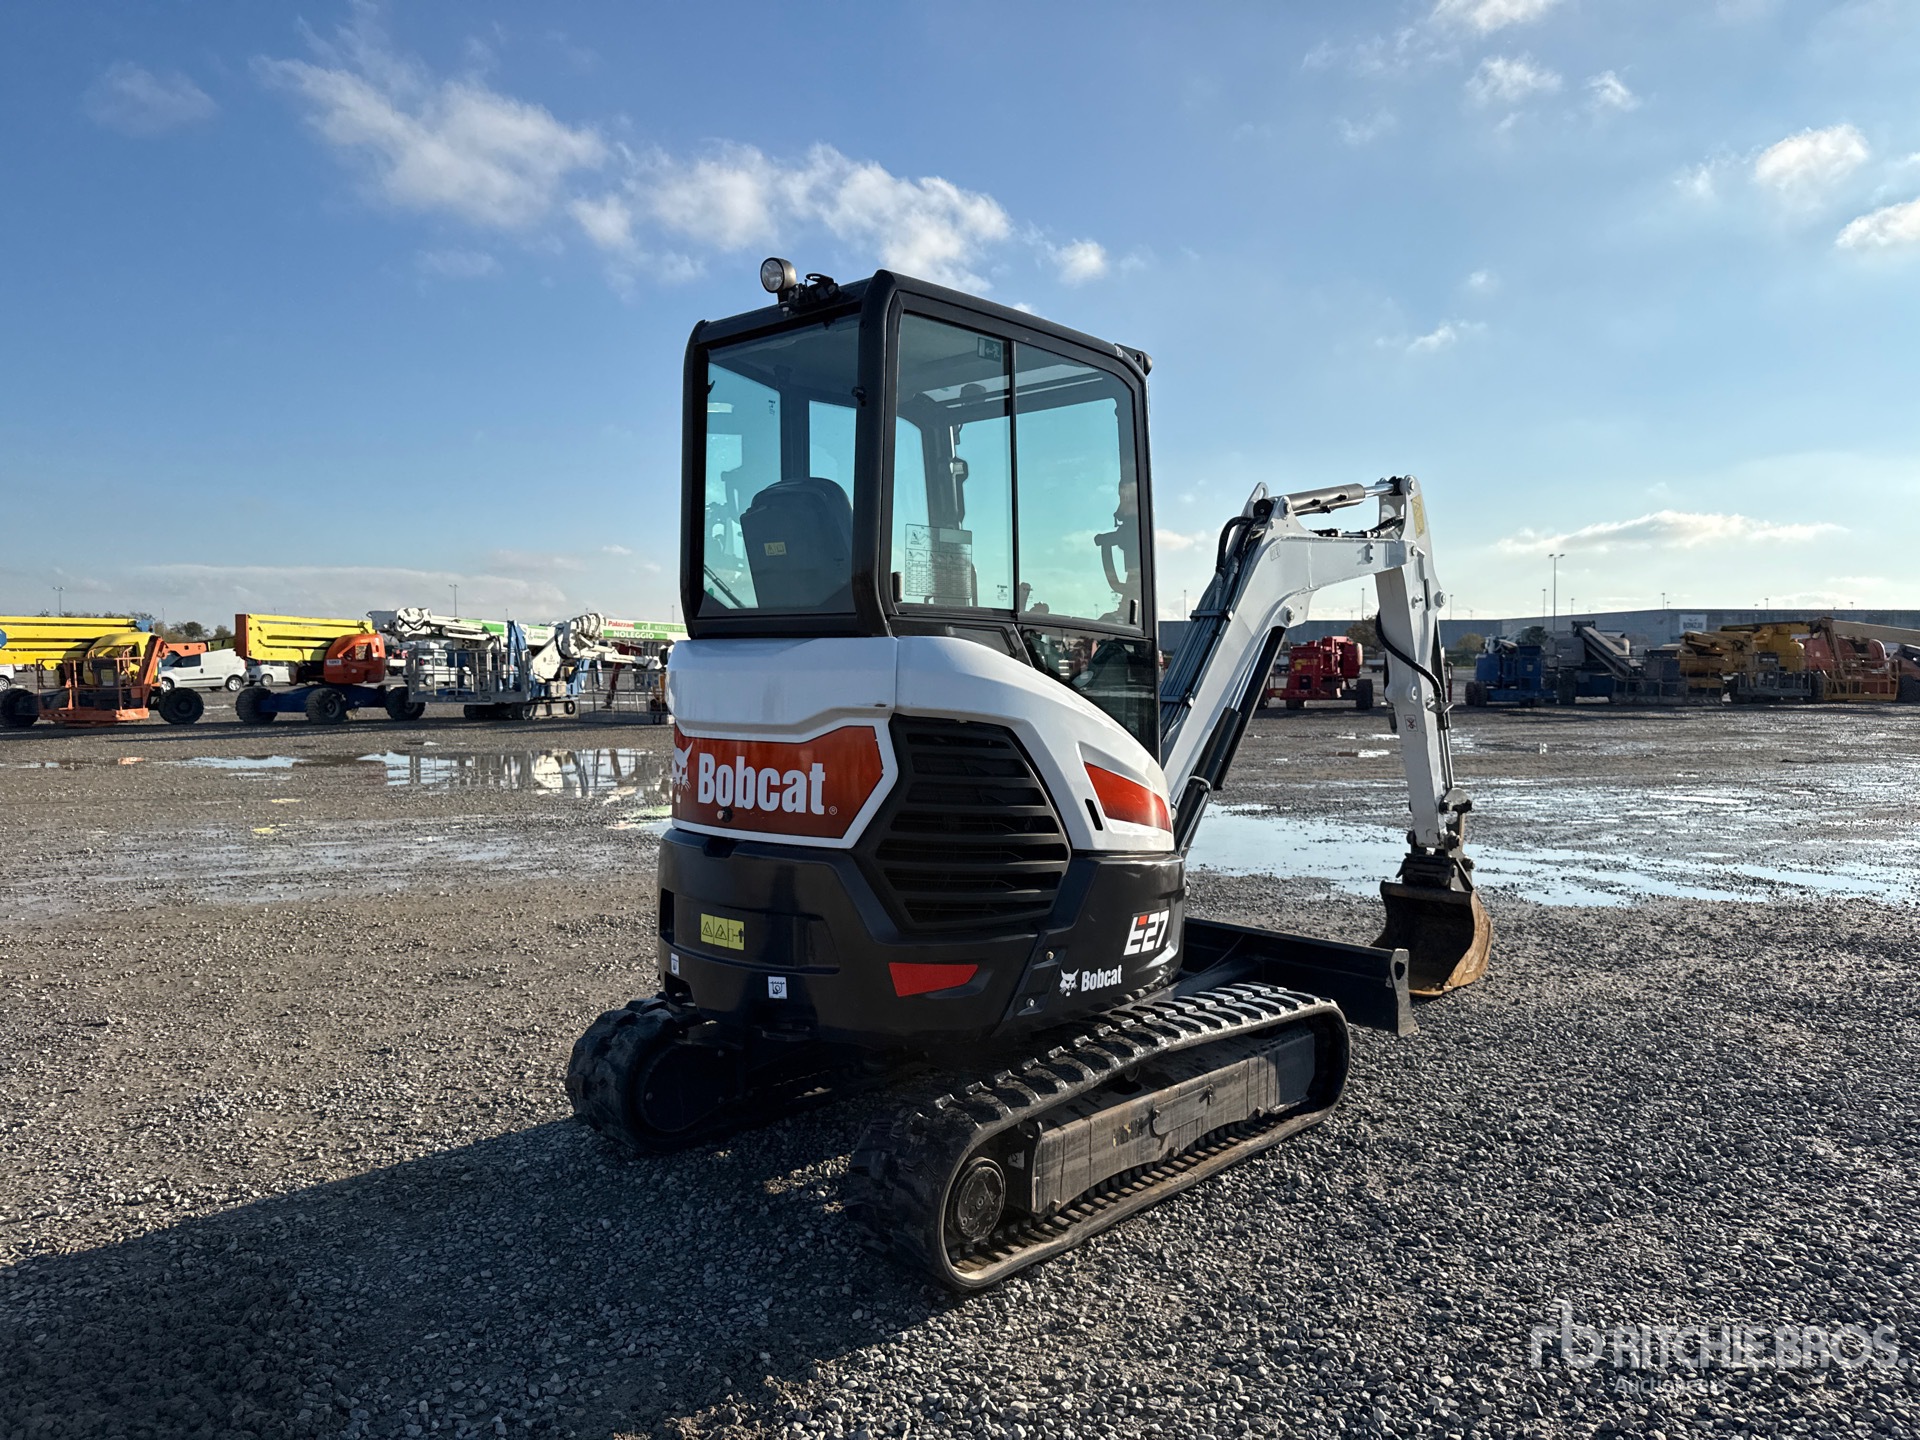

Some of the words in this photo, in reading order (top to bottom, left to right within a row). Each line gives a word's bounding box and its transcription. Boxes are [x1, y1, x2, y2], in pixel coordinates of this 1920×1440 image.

[613, 630, 655, 639] NOLEGGIO
[698, 752, 826, 815] Bobcat
[1123, 909, 1170, 956] E27
[1081, 964, 1122, 992] Bobcat
